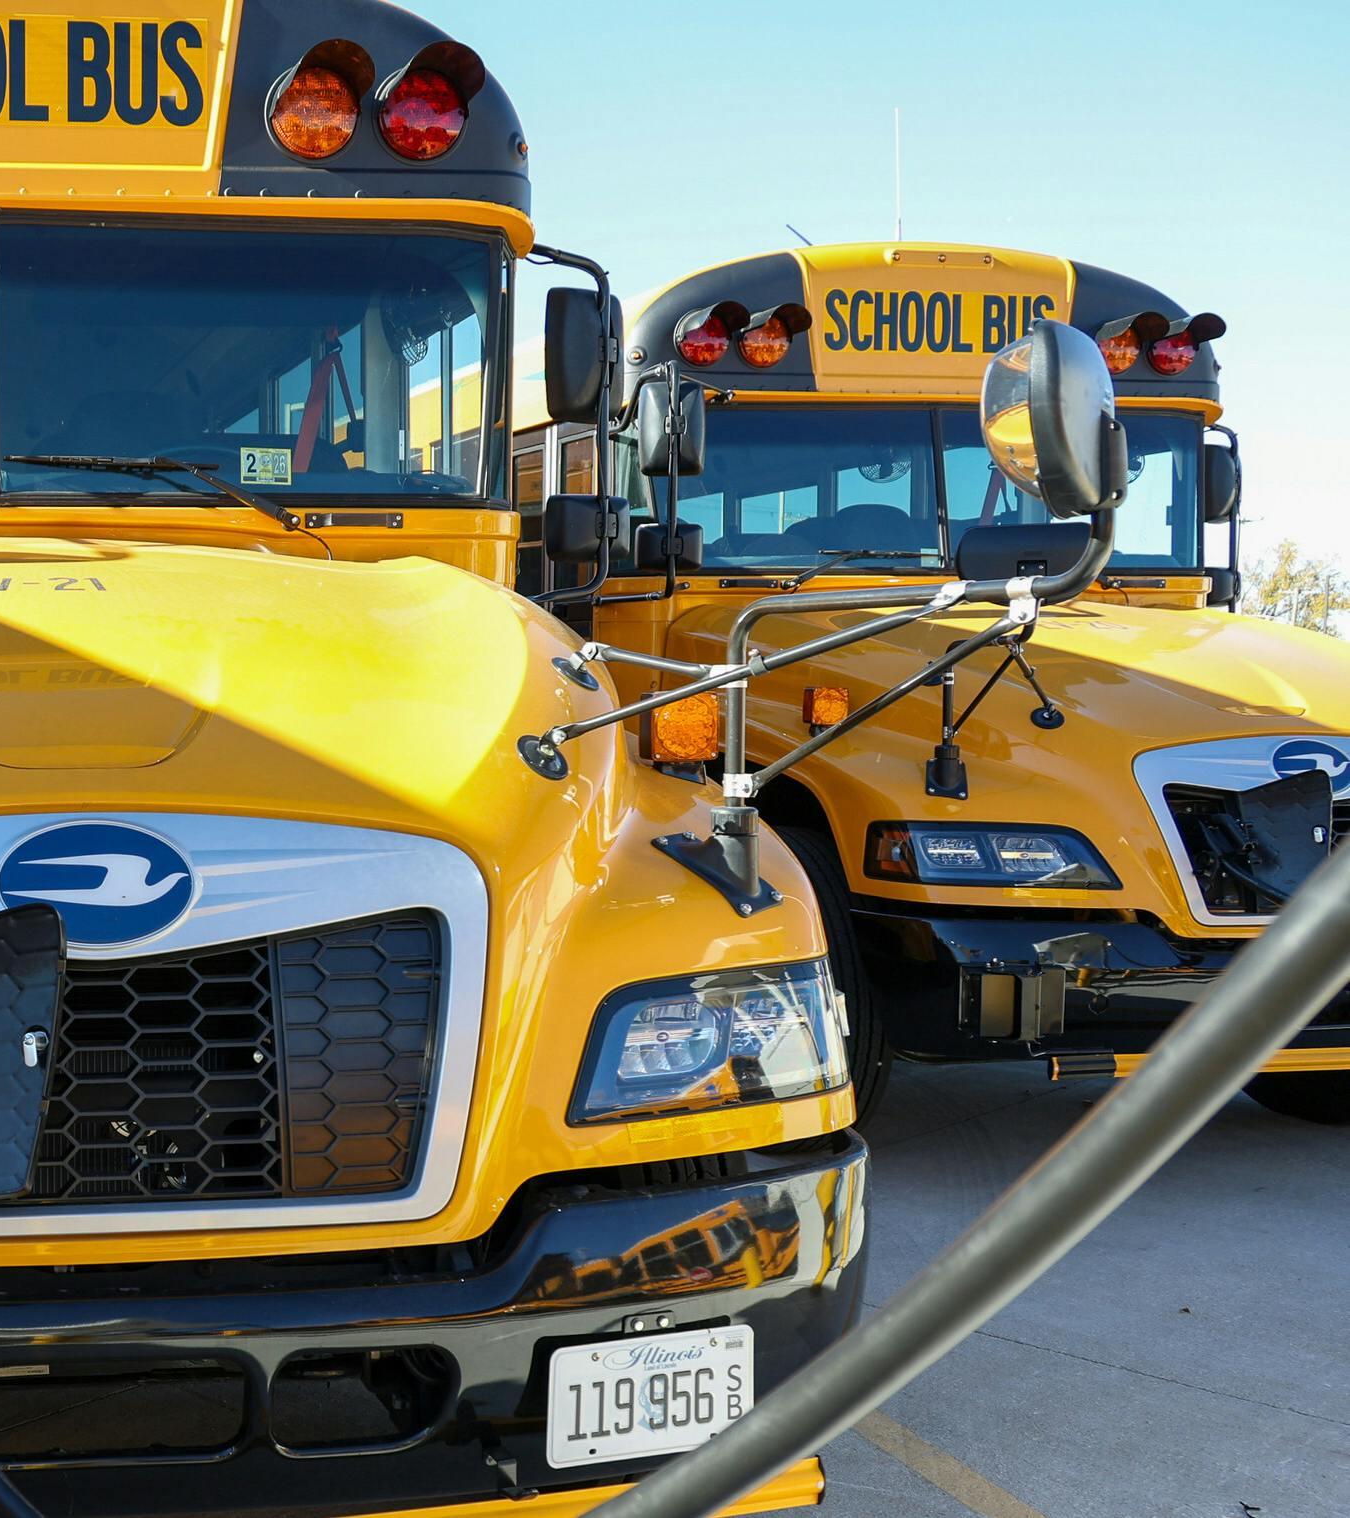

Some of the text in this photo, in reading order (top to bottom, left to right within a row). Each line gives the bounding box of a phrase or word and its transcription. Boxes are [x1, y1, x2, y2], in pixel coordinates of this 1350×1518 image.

[67, 20, 204, 127] BUS
[824, 289, 973, 353] SCHOOL
[246, 453, 286, 474] 2 26
[603, 1342, 705, 1371] Illinois
[567, 1367, 715, 1442] 119 956
